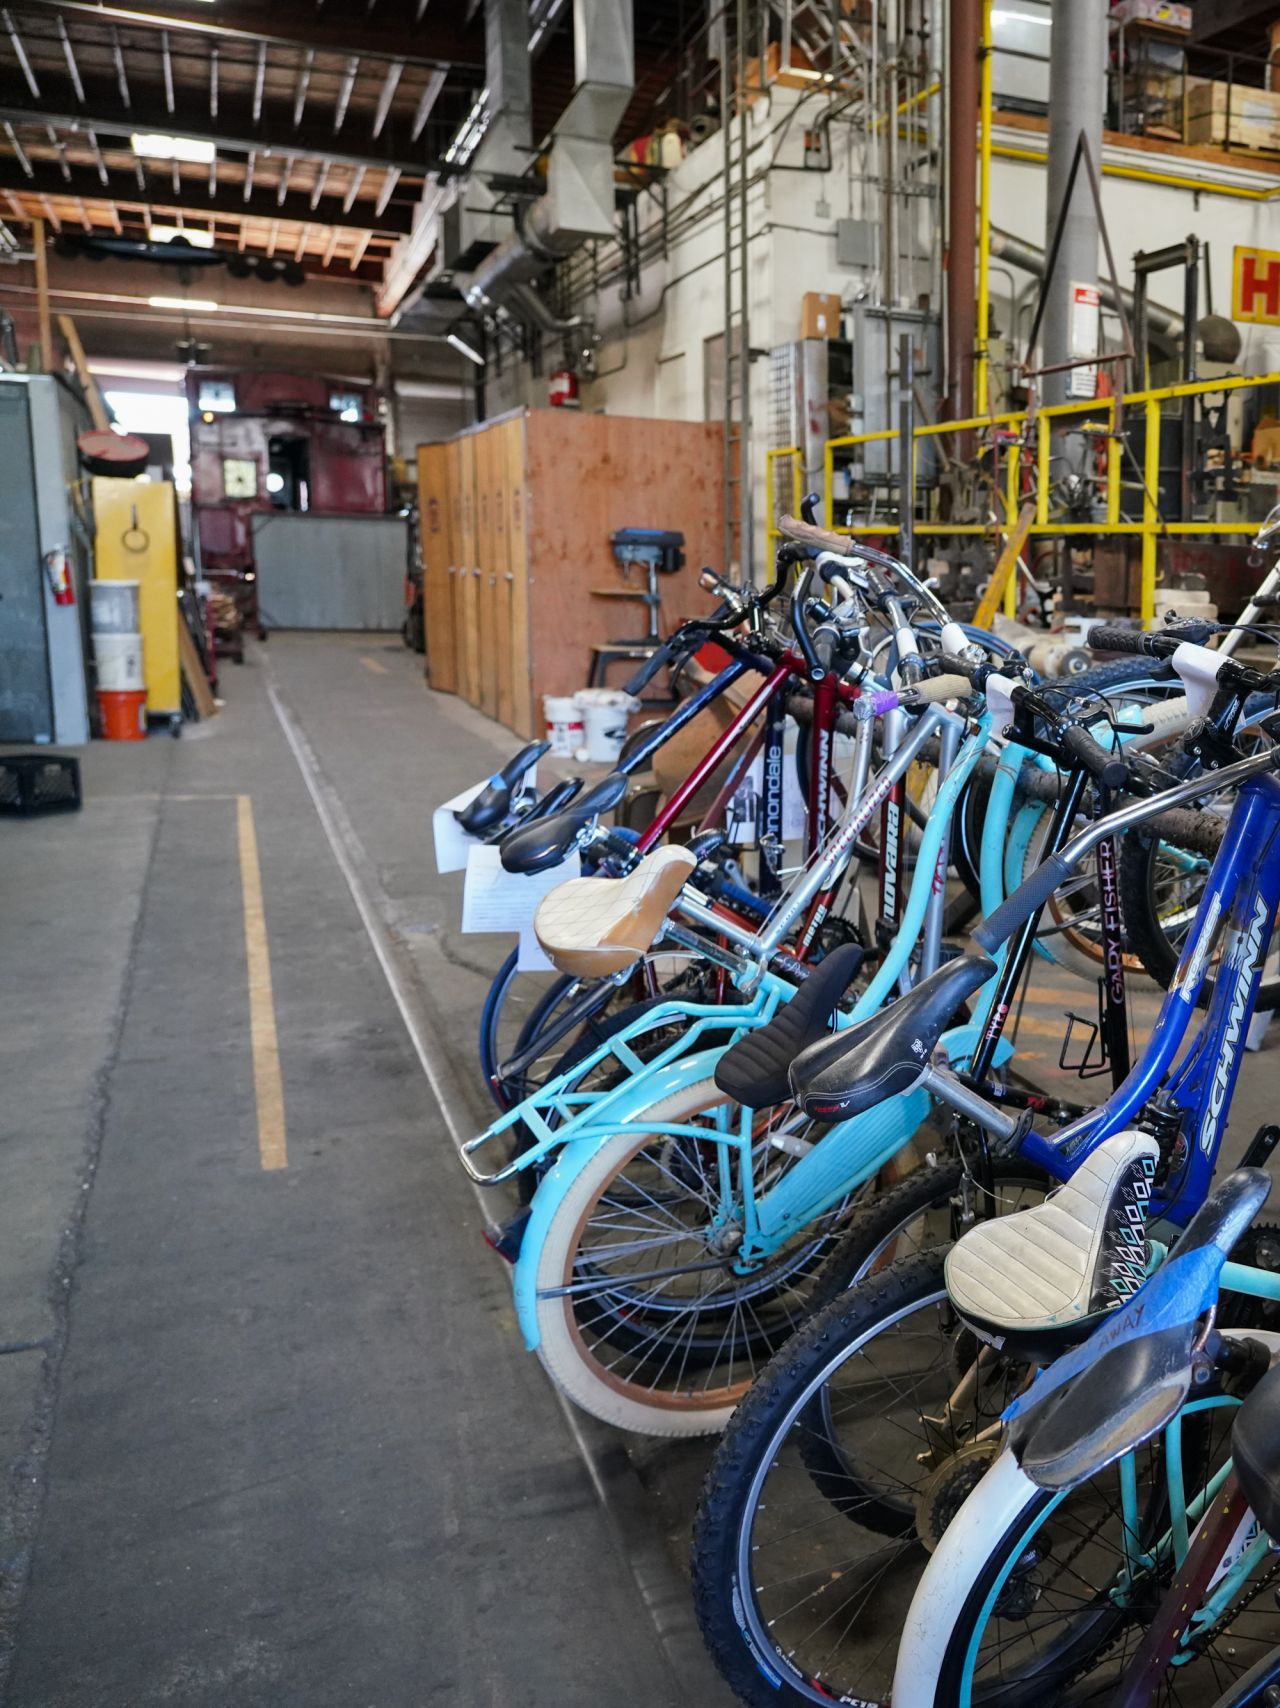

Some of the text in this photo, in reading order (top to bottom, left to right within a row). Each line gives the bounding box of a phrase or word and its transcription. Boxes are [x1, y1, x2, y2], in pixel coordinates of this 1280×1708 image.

[823, 775, 893, 867] SPECIALIZED
[1100, 840, 1121, 932] FISHER
[1180, 891, 1222, 1004] ROCKET
[1199, 891, 1269, 1160] SCHWINN
